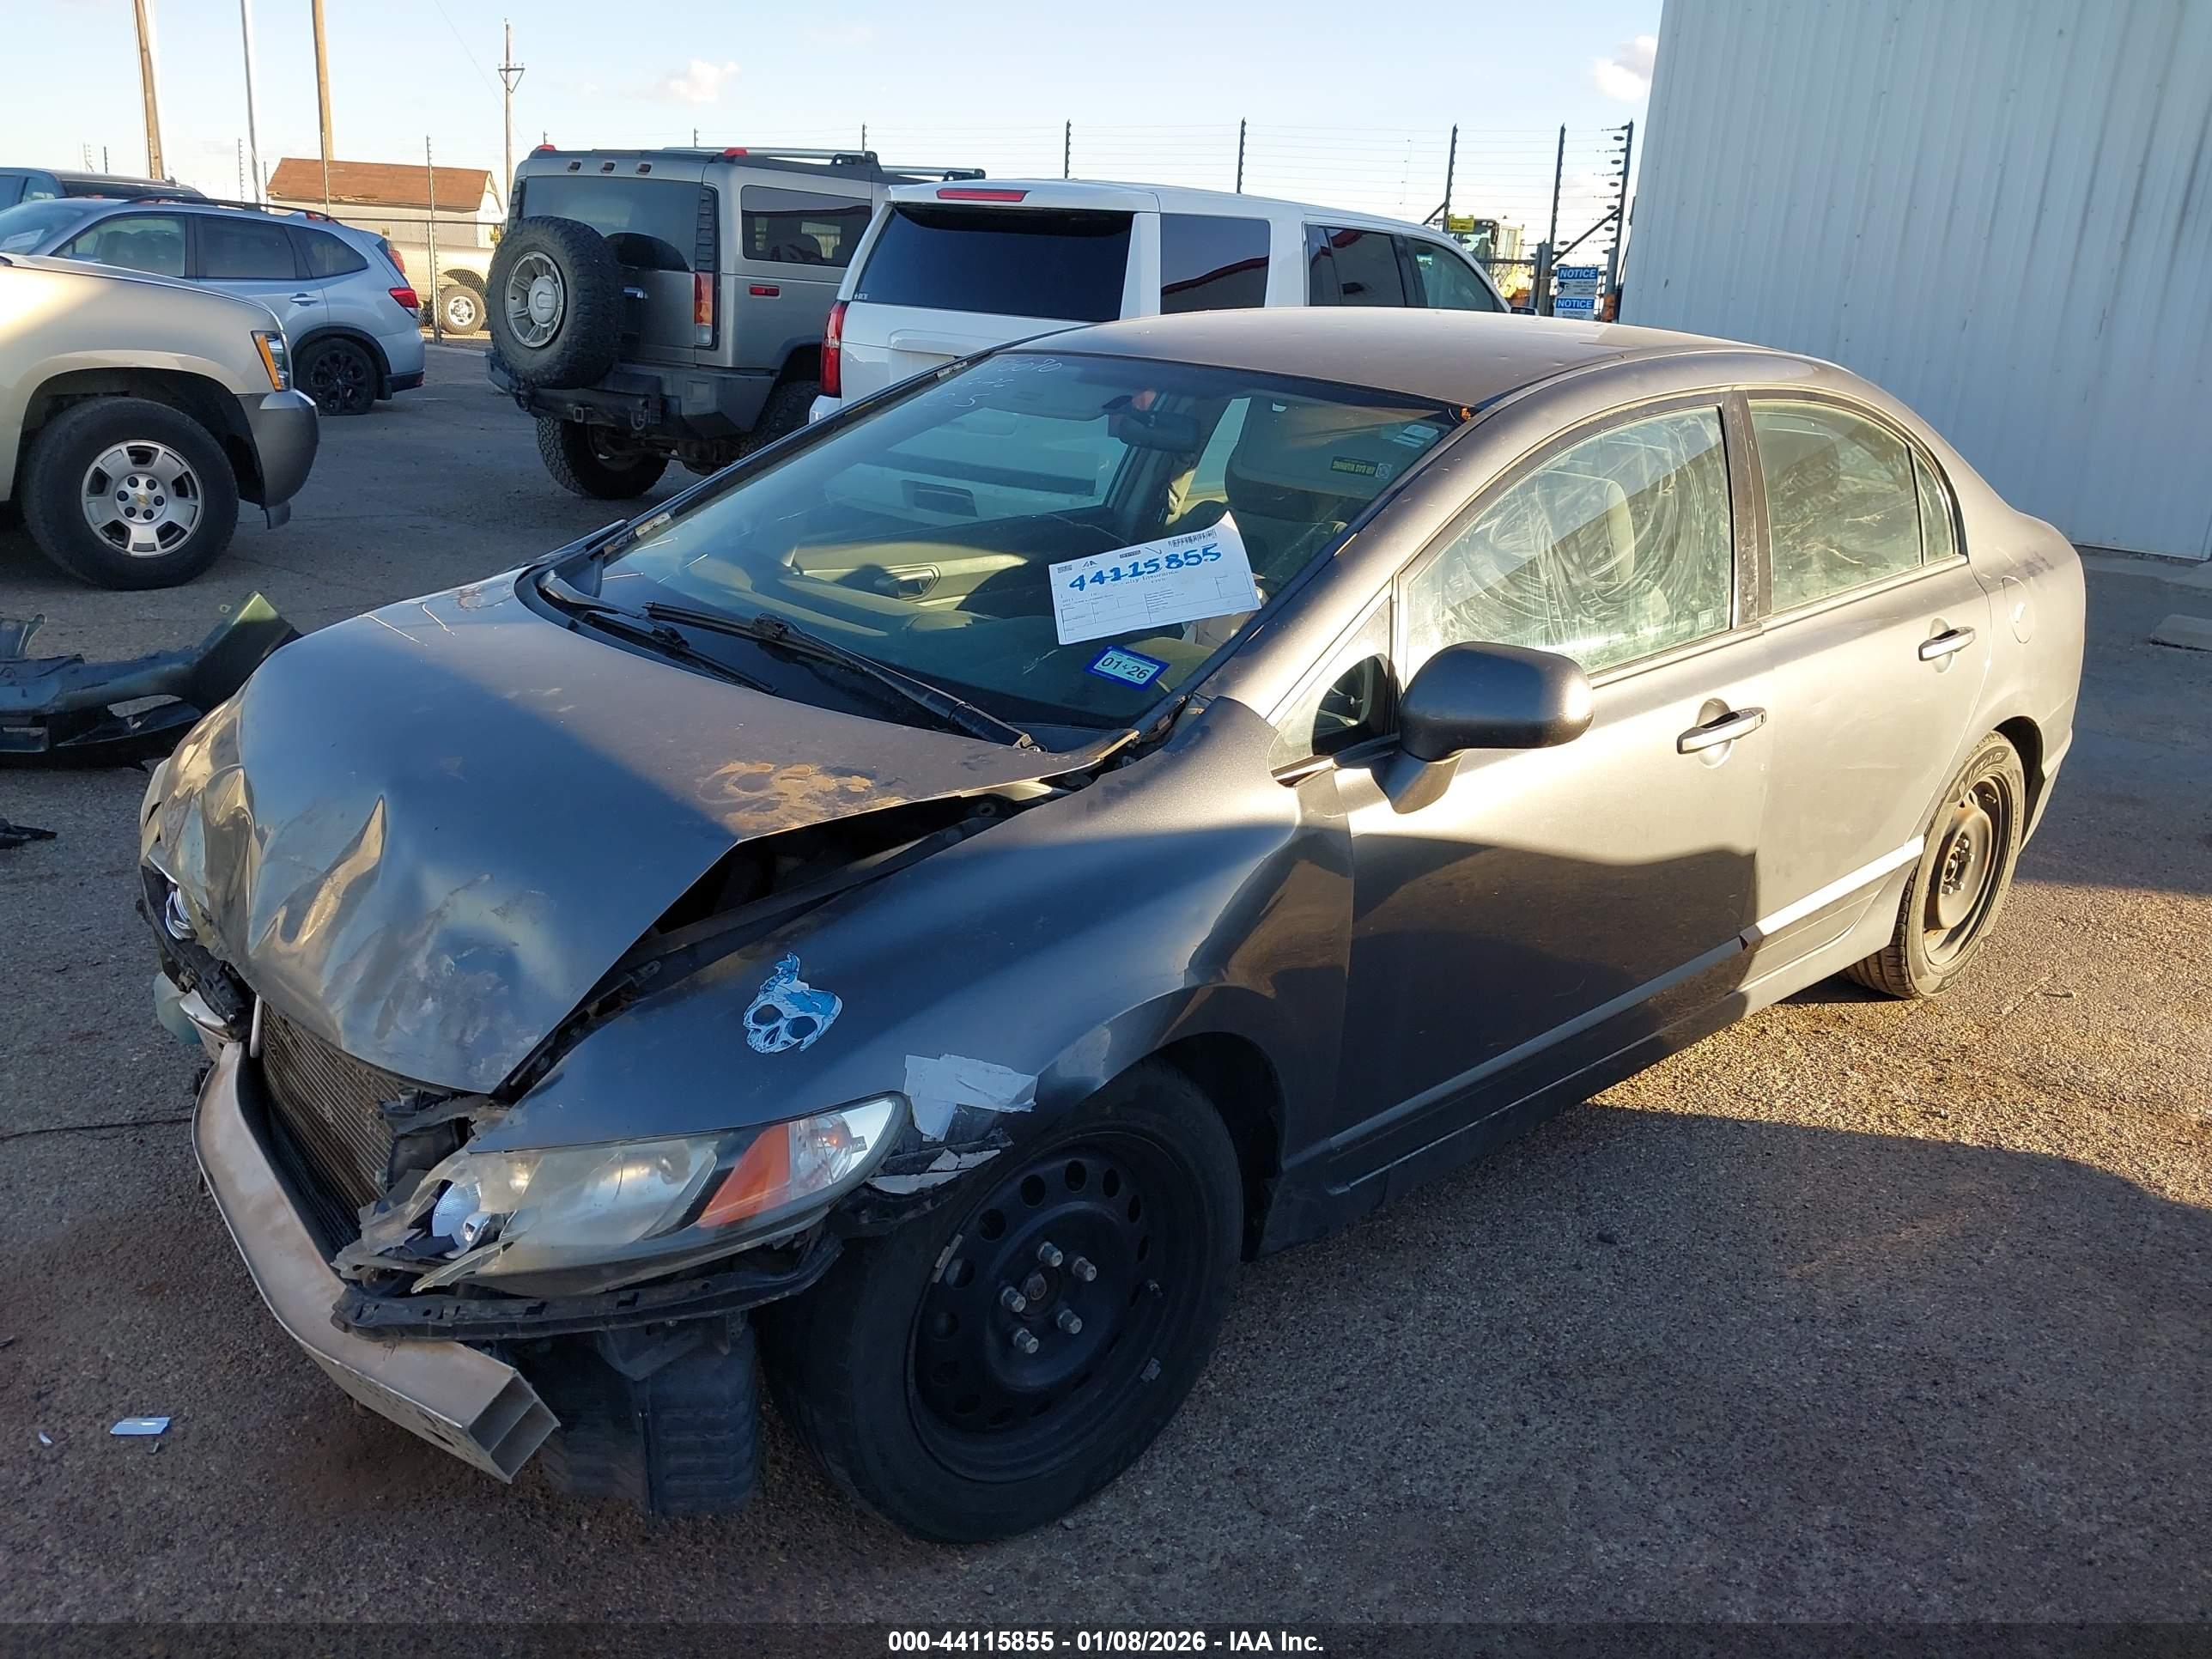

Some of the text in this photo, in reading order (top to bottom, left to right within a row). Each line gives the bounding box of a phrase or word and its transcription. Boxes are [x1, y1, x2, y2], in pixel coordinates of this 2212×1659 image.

[1559, 268, 1597, 278] NOTICE
[1557, 299, 1594, 309] NOTICE
[1068, 542, 1222, 592] 44115855
[1101, 657, 1123, 671] 01
[1126, 665, 1151, 679] 26
